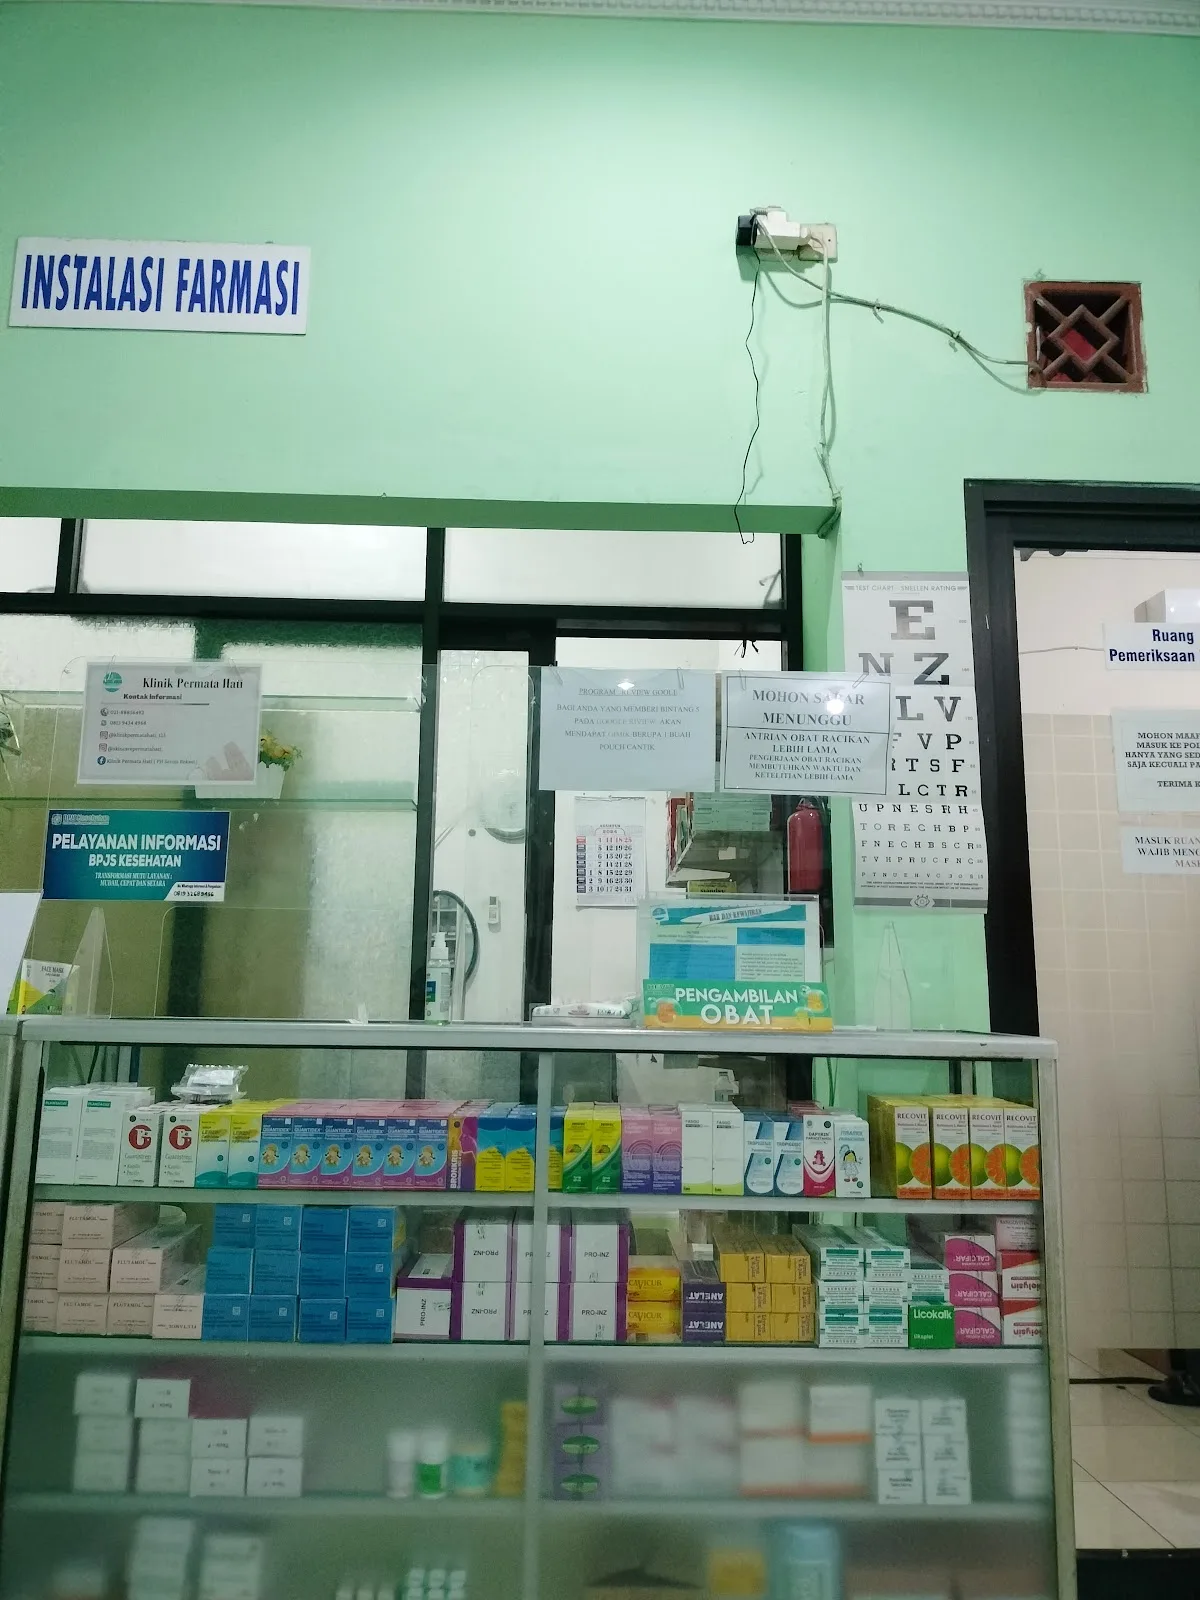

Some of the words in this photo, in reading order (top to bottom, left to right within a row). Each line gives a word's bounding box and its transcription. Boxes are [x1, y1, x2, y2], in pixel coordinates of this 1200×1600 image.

[21, 254, 165, 313] INSTALASI
[175, 258, 300, 316] FARMASI
[889, 600, 936, 640] E
[1152, 628, 1194, 644] Ruang
[1109, 648, 1195, 662] Pemeriksaan
[914, 652, 950, 685] Z
[142, 678, 174, 688] Klinik
[177, 678, 220, 689] Permata
[752, 690, 809, 704] MOHON
[896, 696, 924, 720] L
[934, 696, 962, 722] V
[763, 712, 852, 726] MENUNGGU
[744, 732, 788, 741] ANTRIAN
[790, 734, 818, 742] OBAT
[822, 734, 870, 744] RACIKAN
[918, 733, 932, 750] V
[946, 734, 962, 750] P
[807, 746, 838, 754] LAMA
[52, 834, 138, 850] PELAYANAN
[141, 834, 222, 850] INFORMASI
[1135, 836, 1171, 845] MASUK
[1138, 848, 1170, 856] WAJIB
[88, 854, 117, 868] BPJS
[118, 854, 182, 868] KESEHATAN
[675, 988, 798, 1004] PENGAMBILAN
[700, 1004, 774, 1025] OBAT
[628, 1279, 662, 1290] CAVICUR
[688, 1292, 724, 1300] ANELAT
[628, 1312, 662, 1322] CAVICUR
[914, 1308, 952, 1320] Licokalk
[688, 1320, 724, 1328] ANELAT
